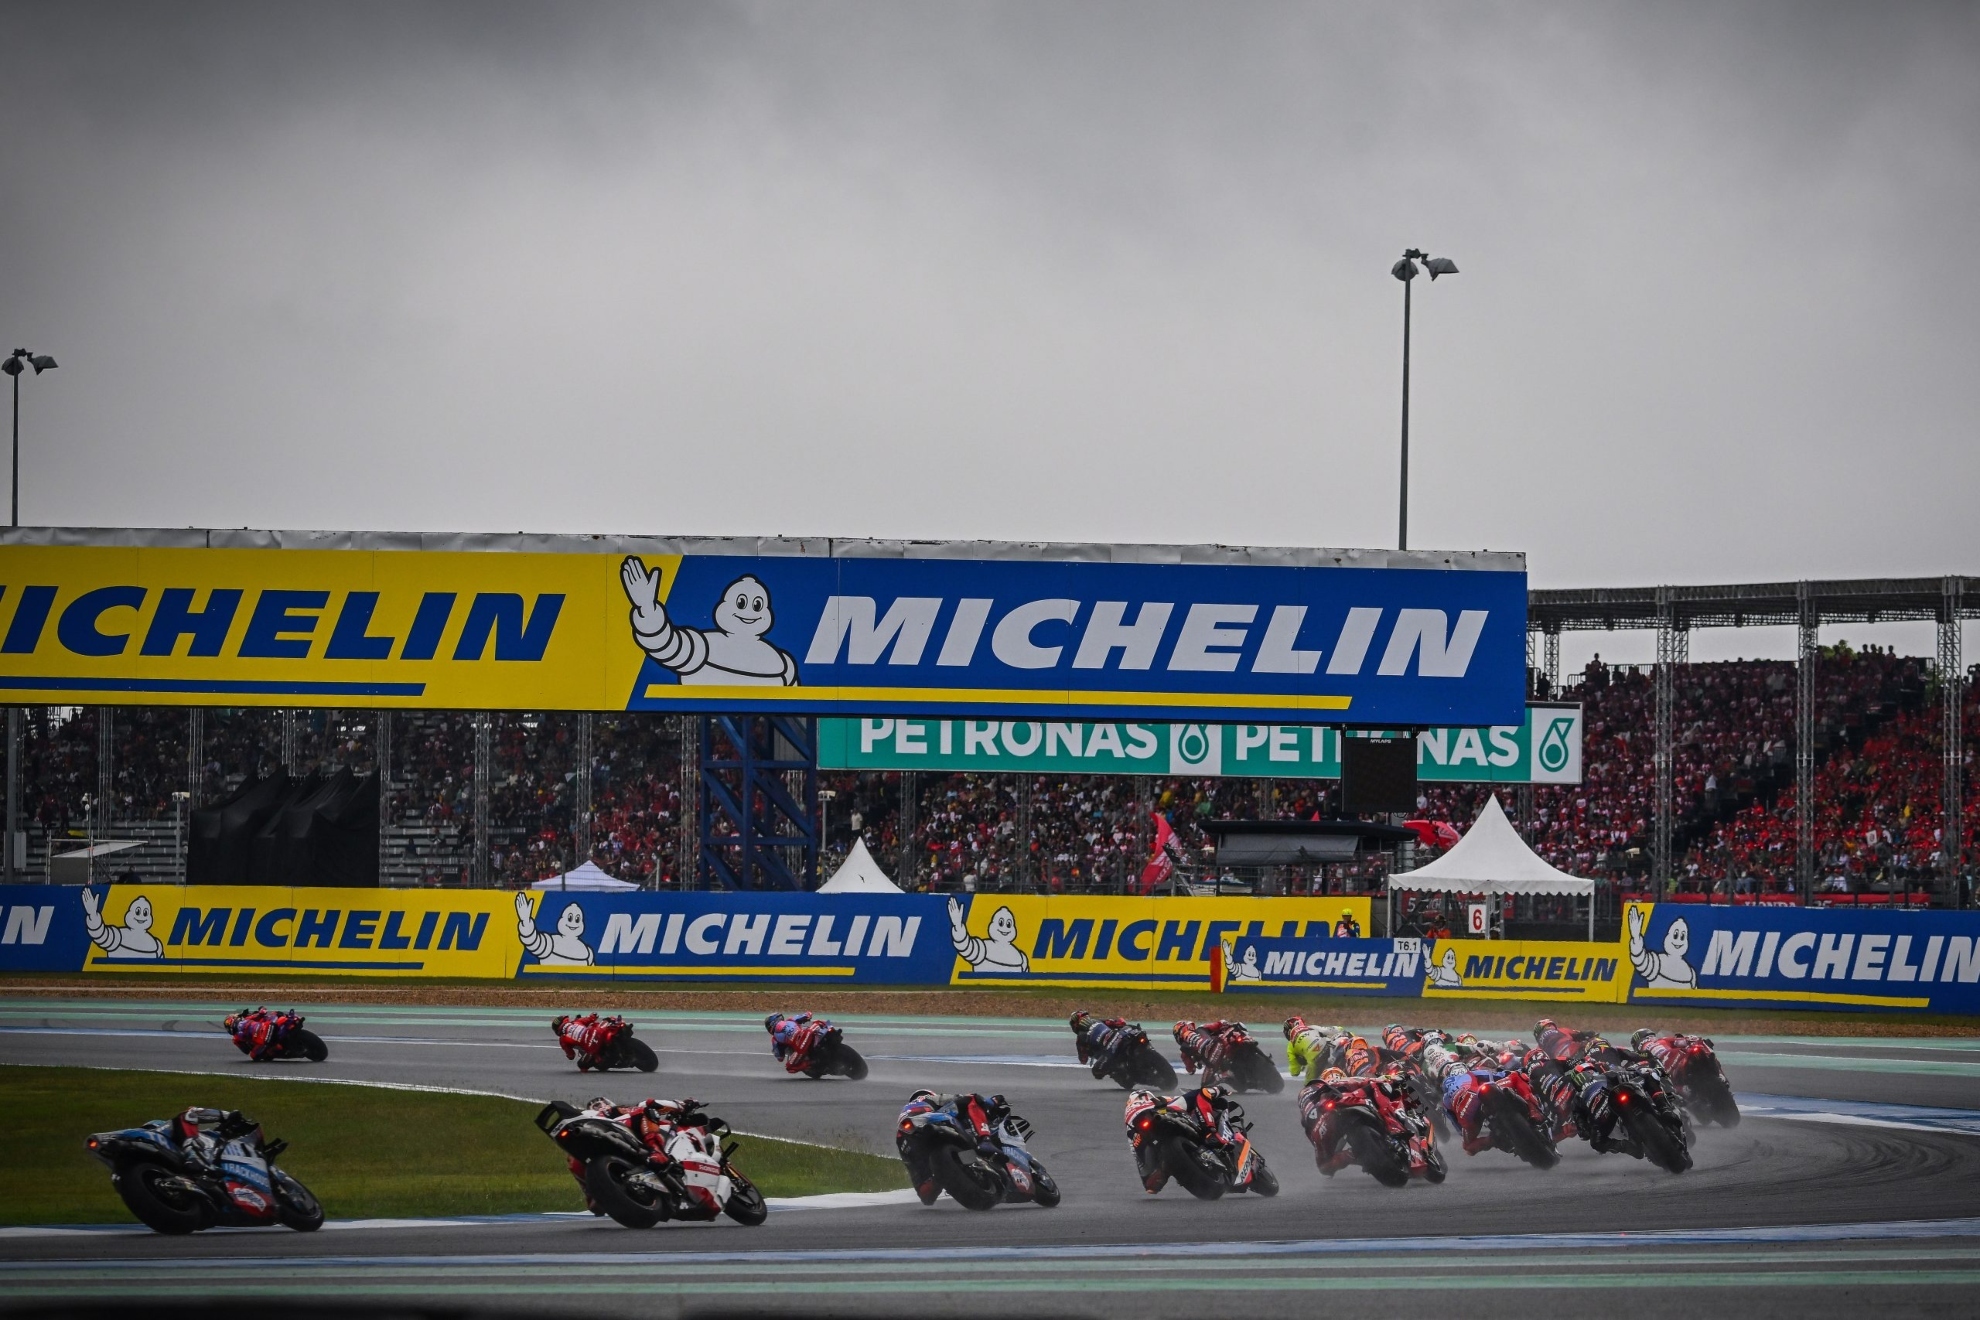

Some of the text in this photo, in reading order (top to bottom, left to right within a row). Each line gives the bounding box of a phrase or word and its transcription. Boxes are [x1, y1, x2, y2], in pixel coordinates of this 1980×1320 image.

[0, 586, 565, 662] ICHELIN
[804, 595, 1489, 678] MICHELIN
[860, 720, 1158, 759] PETRONAS
[0, 906, 55, 946] N
[169, 908, 490, 950] MICHELIN
[597, 913, 922, 957] MICHELIN
[1472, 908, 1483, 931] 6
[1262, 950, 1420, 978] MICHELIN
[1397, 940, 1418, 951] T6.1
[1701, 929, 1980, 983] MICHELIN
[1464, 955, 1618, 981] MICHELIN
